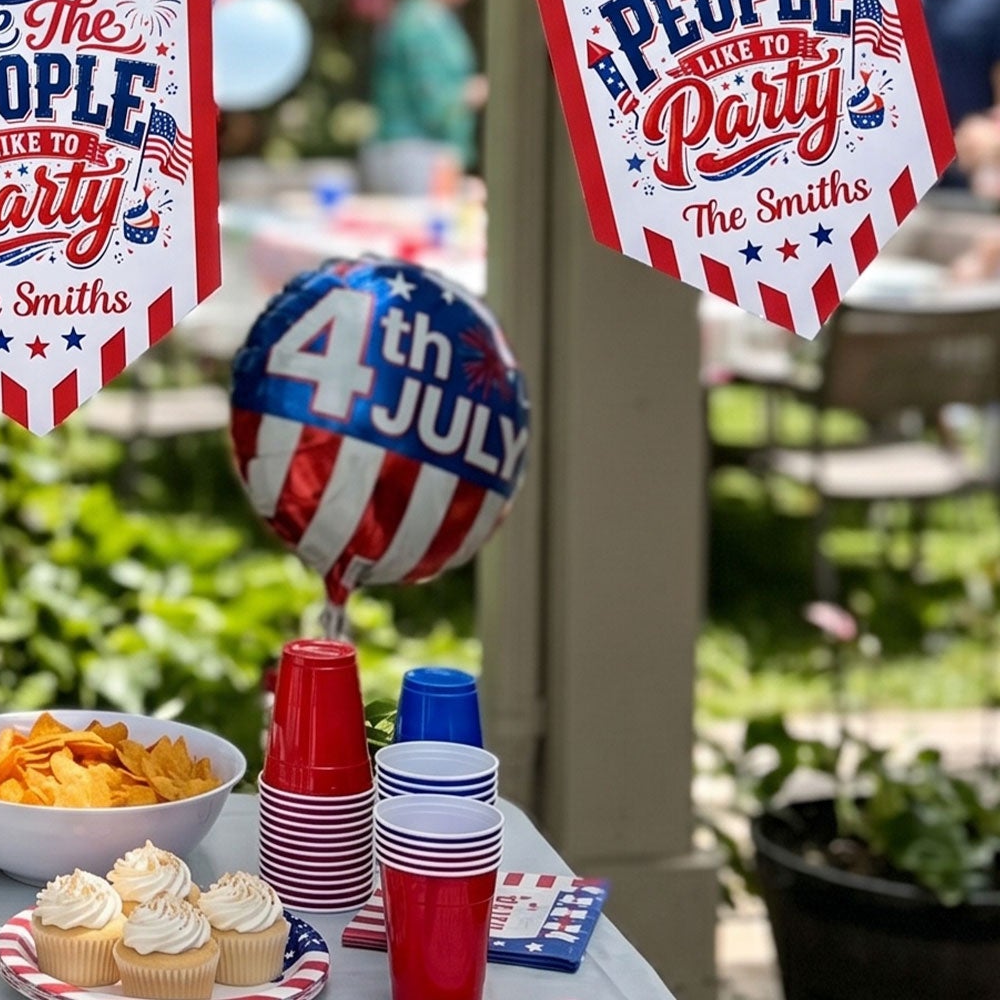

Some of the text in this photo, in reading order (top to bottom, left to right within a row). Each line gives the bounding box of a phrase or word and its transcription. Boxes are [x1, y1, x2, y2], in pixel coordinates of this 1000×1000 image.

[697, 33, 790, 75] LIKE TO
[52, 135, 80, 156] TO
[643, 48, 843, 189] Party
[682, 170, 871, 238] The Smiths
[14, 279, 131, 316] Smiths
[266, 288, 452, 421] 4th
[371, 377, 528, 481] JULY
